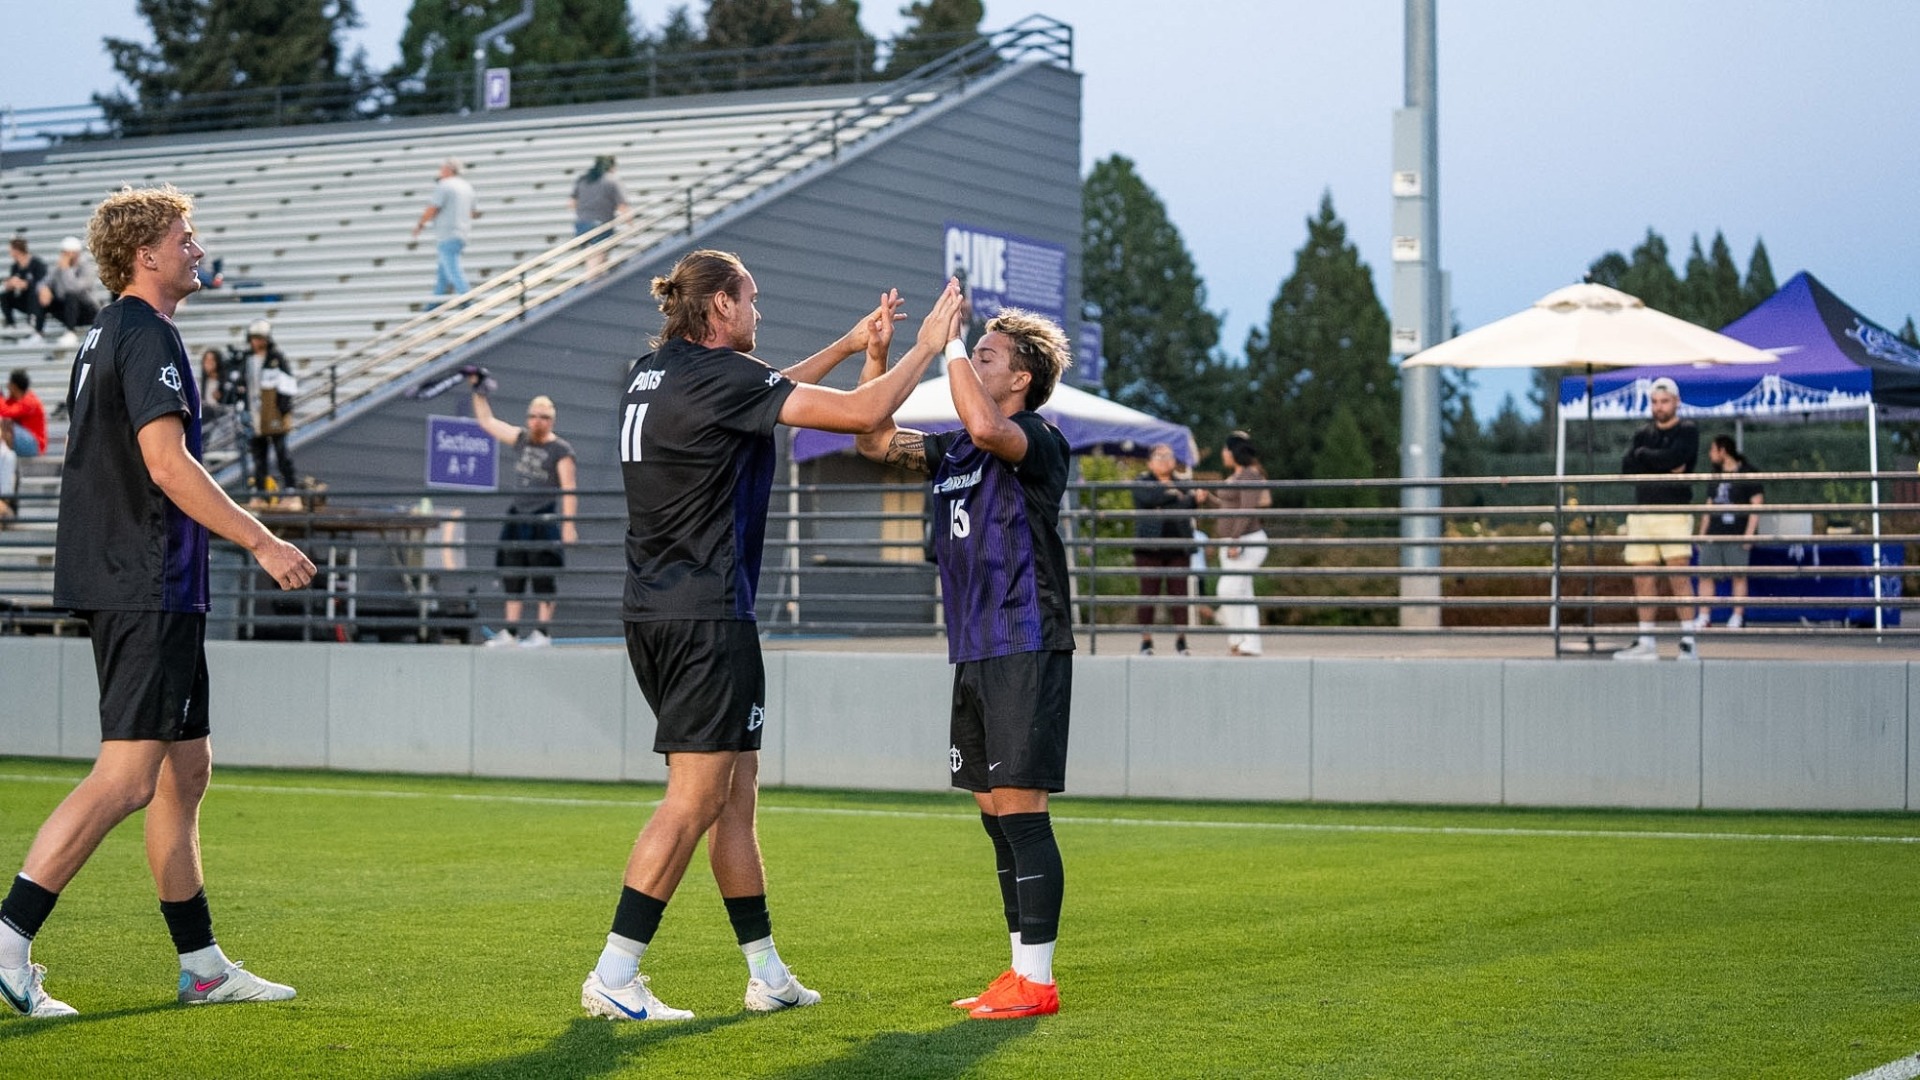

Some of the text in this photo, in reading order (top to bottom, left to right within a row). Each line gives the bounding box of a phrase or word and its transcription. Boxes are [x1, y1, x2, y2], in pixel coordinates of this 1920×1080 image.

[436, 430, 489, 454] Sections
[621, 403, 649, 462] 11
[949, 498, 970, 540] 15
